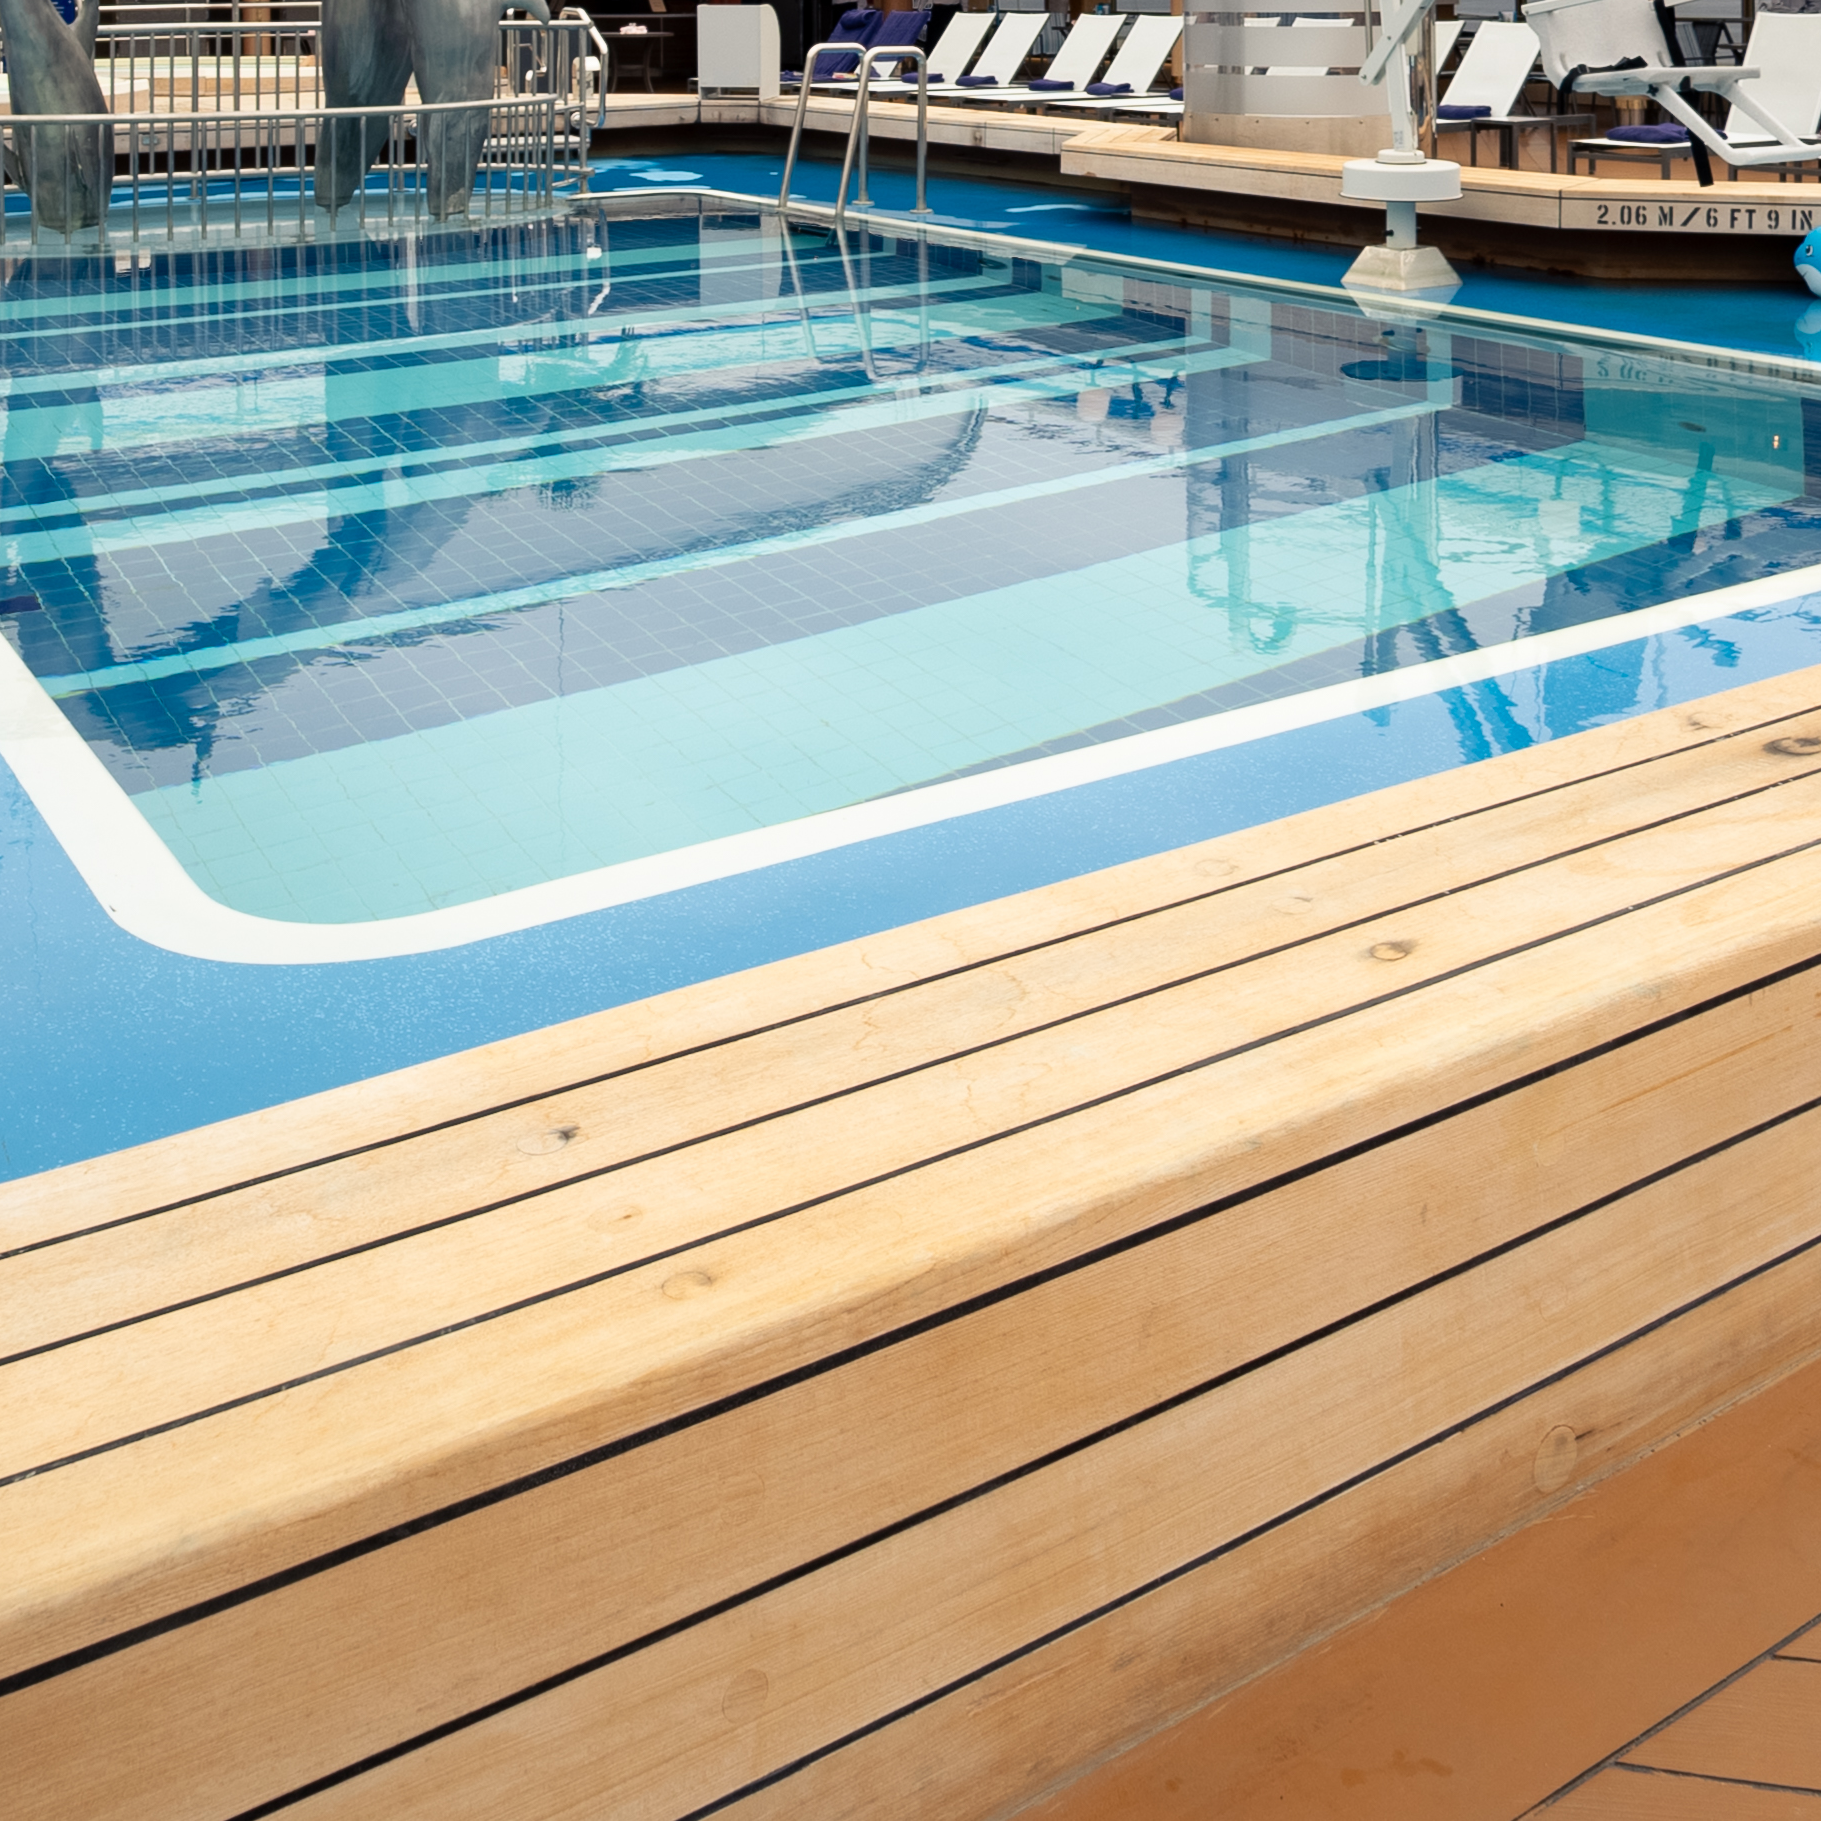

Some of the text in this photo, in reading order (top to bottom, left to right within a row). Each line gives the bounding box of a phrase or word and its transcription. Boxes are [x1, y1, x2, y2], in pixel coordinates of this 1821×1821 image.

[1596, 204, 1648, 226] 2.06
[1729, 207, 1757, 230] FT
[1767, 208, 1781, 230] 9
[1791, 209, 1814, 231] IN
